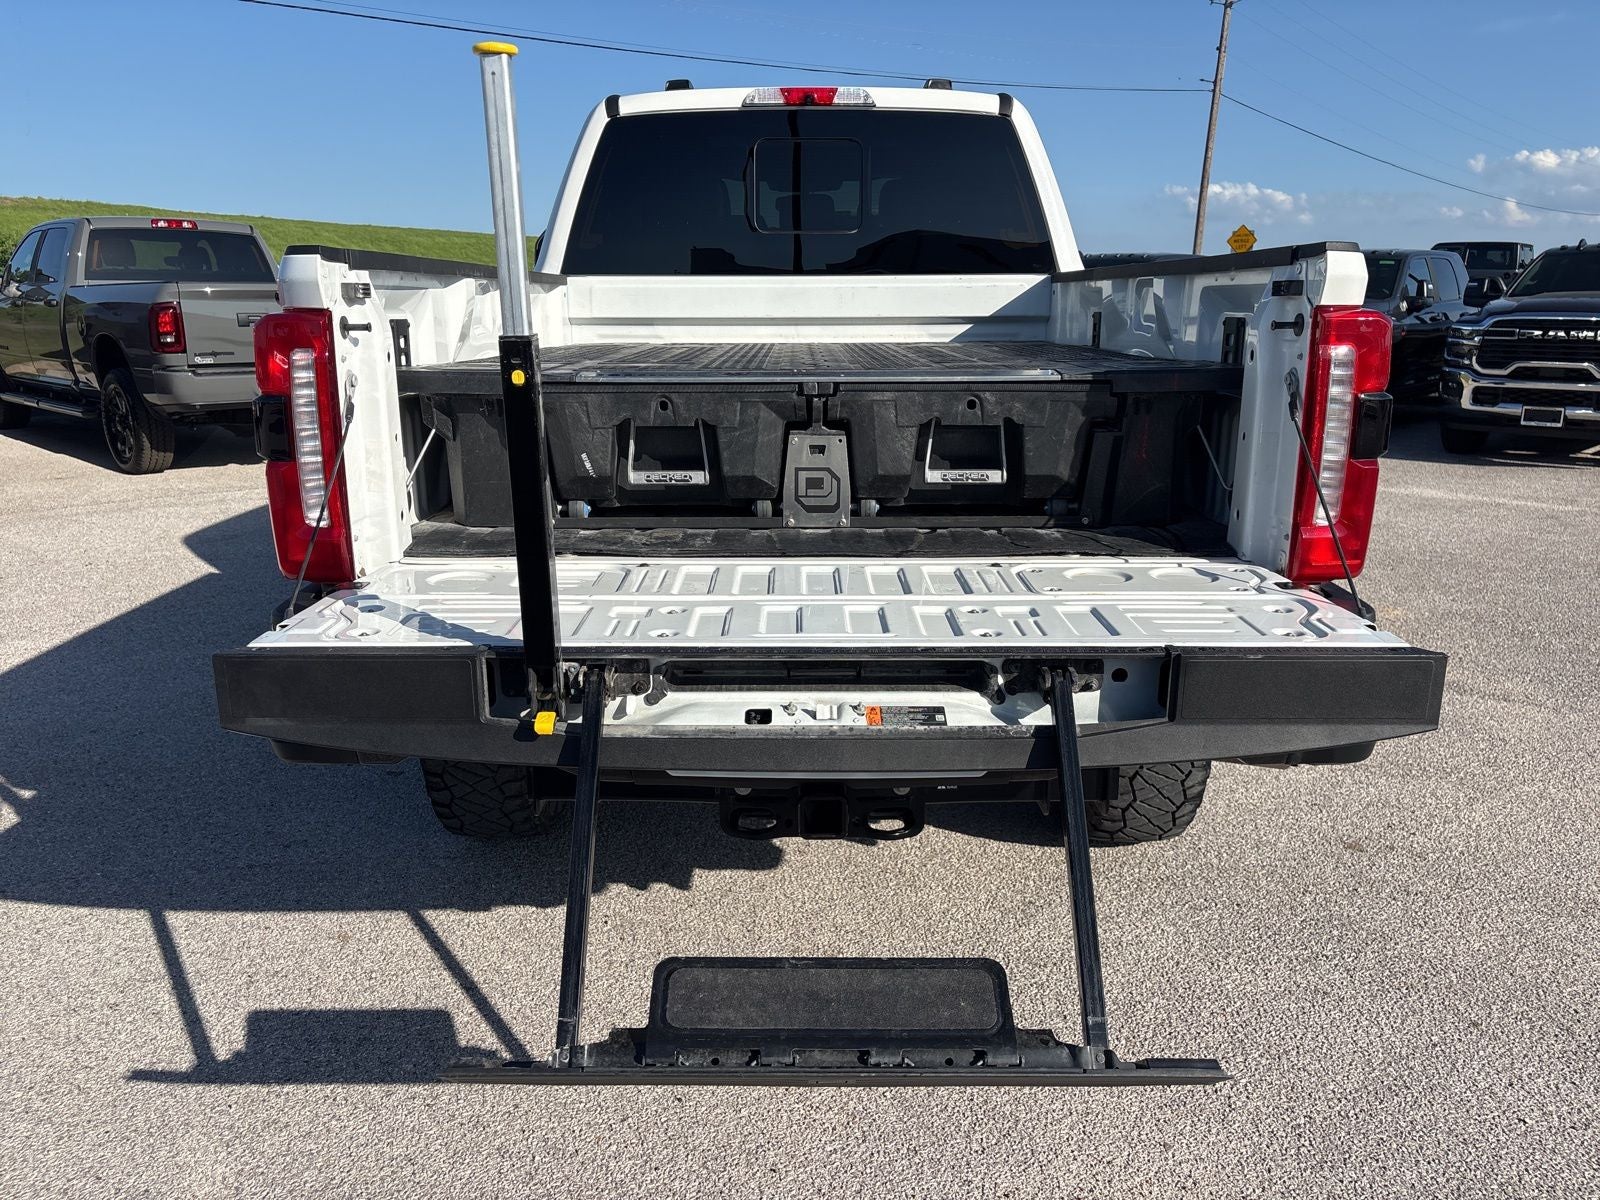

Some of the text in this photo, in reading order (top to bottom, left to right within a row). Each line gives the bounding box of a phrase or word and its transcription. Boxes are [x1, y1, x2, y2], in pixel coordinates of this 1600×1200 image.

[1519, 329, 1595, 340] RAM
[643, 472, 693, 483] DECKED
[940, 471, 990, 482] DECKED
